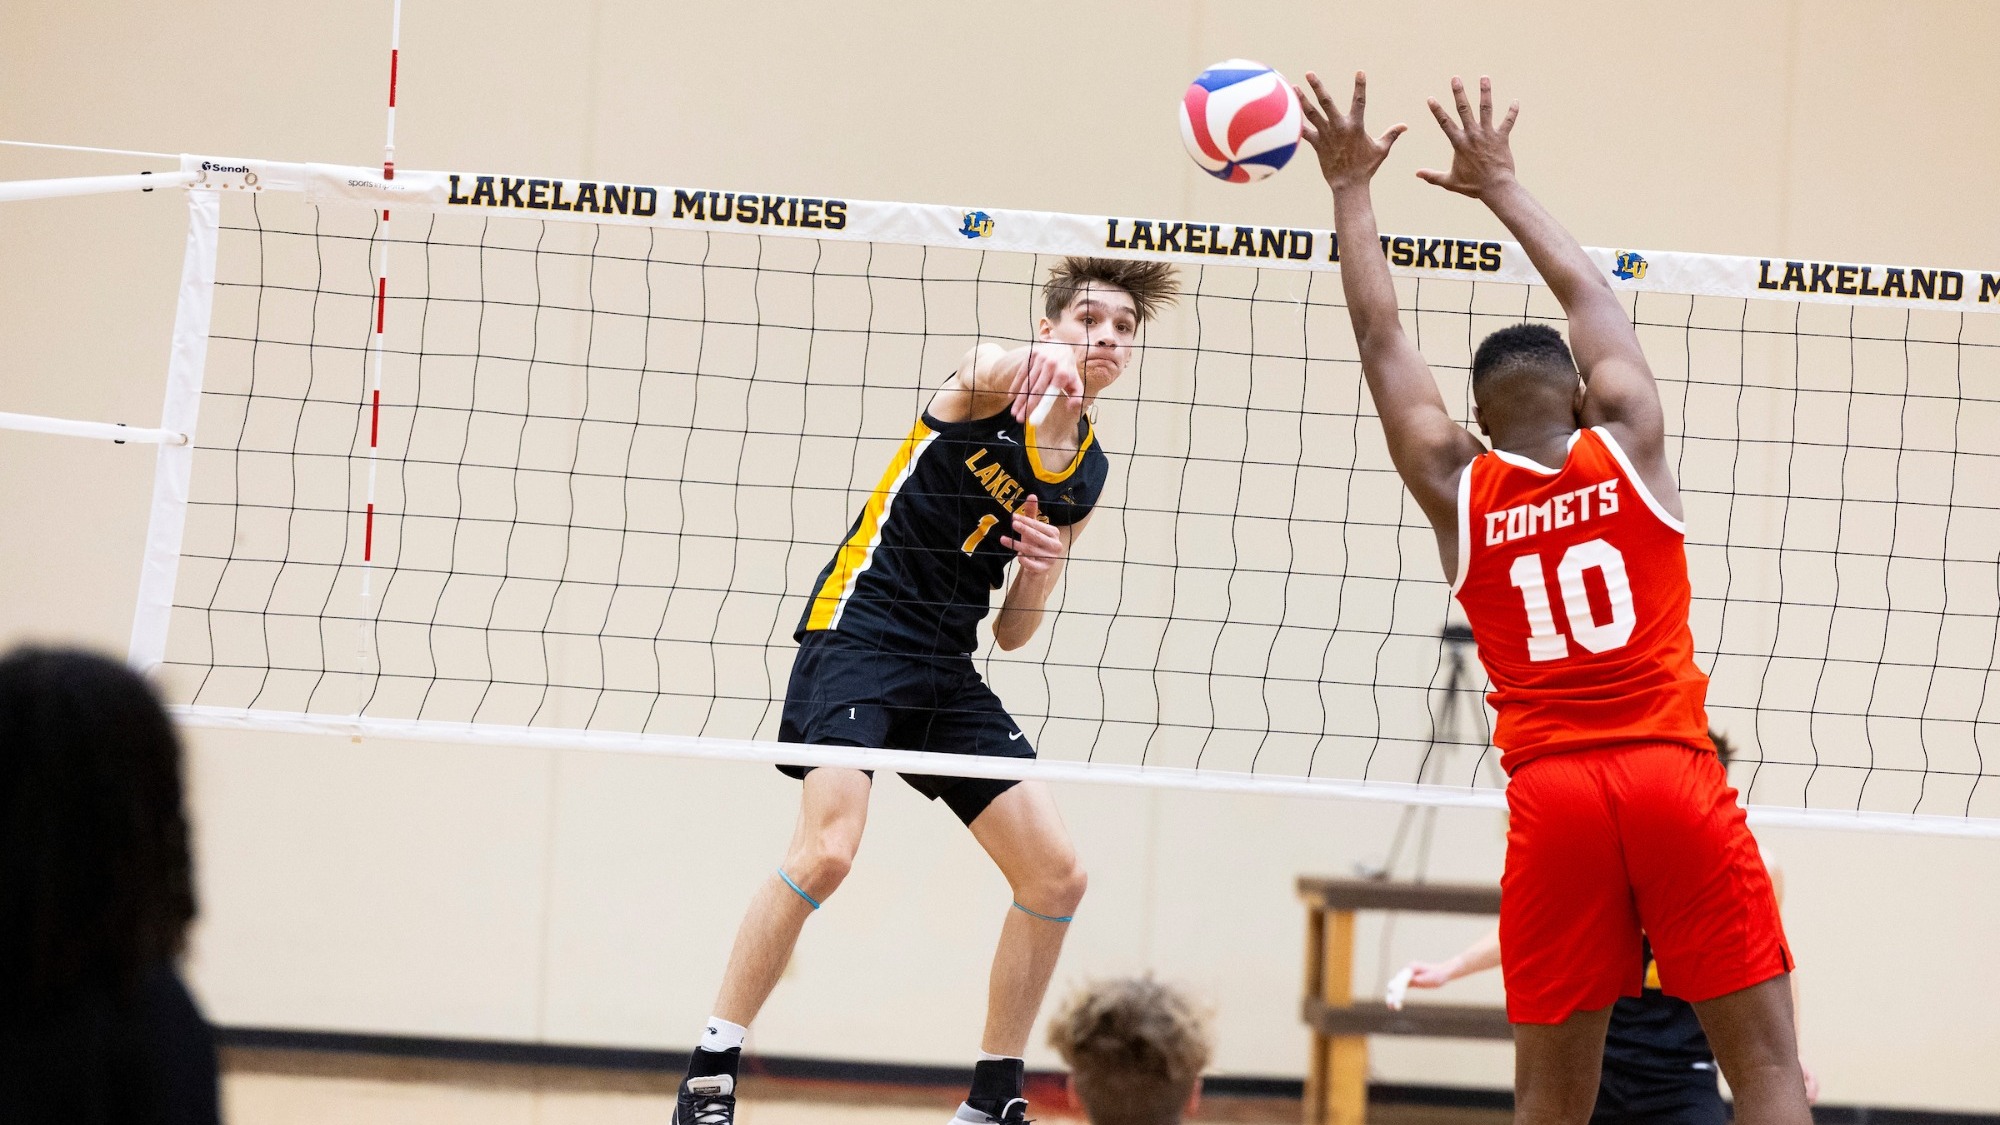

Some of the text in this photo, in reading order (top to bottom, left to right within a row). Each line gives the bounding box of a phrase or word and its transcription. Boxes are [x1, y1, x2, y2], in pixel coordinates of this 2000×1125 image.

[212, 163, 250, 173] Senoh
[347, 179, 373, 188] sports
[448, 175, 847, 230] LAKELAND MUSKIES
[1106, 218, 1313, 261] LAKELAND
[1758, 259, 1964, 301] LAKELAND
[964, 447, 1050, 525] LAKEL
[1484, 477, 1619, 547] COMETS
[961, 513, 999, 557] 1
[1509, 538, 1637, 662] 10
[848, 707, 856, 720] 1
